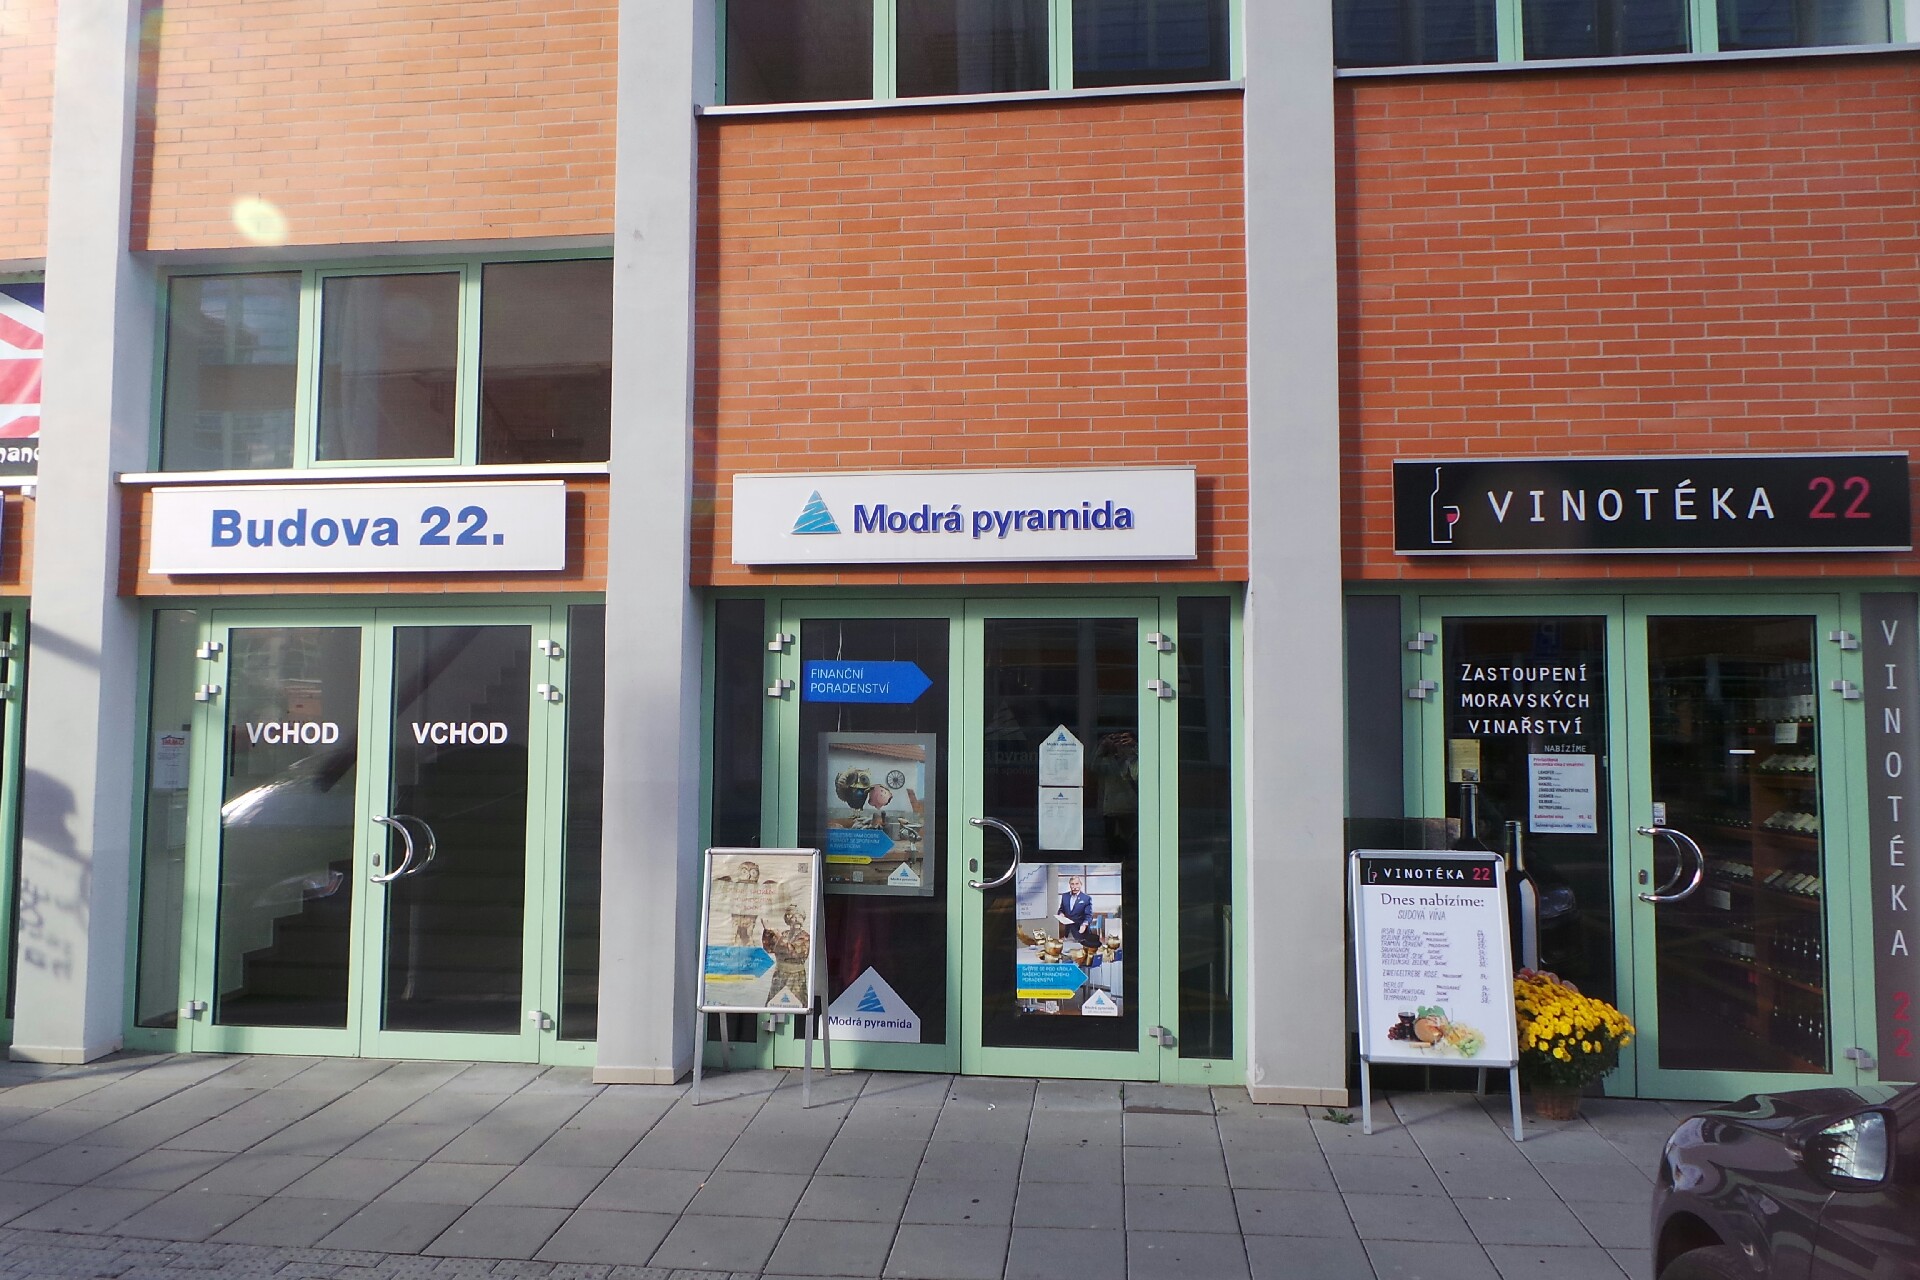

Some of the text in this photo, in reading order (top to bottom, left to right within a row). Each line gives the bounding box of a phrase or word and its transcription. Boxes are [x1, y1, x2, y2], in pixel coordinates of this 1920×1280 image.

[1488, 476, 1872, 523] VINOTÉKA 22
[211, 506, 505, 548] Budova 22.
[853, 500, 1134, 540] Modrá pyramida
[811, 667, 864, 680] FINANČNÍ
[1461, 664, 1587, 682] ZASTOUPENÍ
[811, 680, 890, 695] PORADENSTVÍ
[1461, 690, 1589, 708] MORAVSKÝCH
[246, 722, 508, 744] VCHOD VCHOD
[1468, 716, 1582, 735] VINAŘSTVÍ
[1544, 744, 1587, 753] NABÍZÍME
[1882, 620, 1913, 1057] VINOTÉKA 22
[1384, 867, 1490, 880] VINOTÉKA 22
[1381, 893, 1484, 907] Dnes nabízíme:
[828, 1016, 912, 1029] Modrá pyramida
